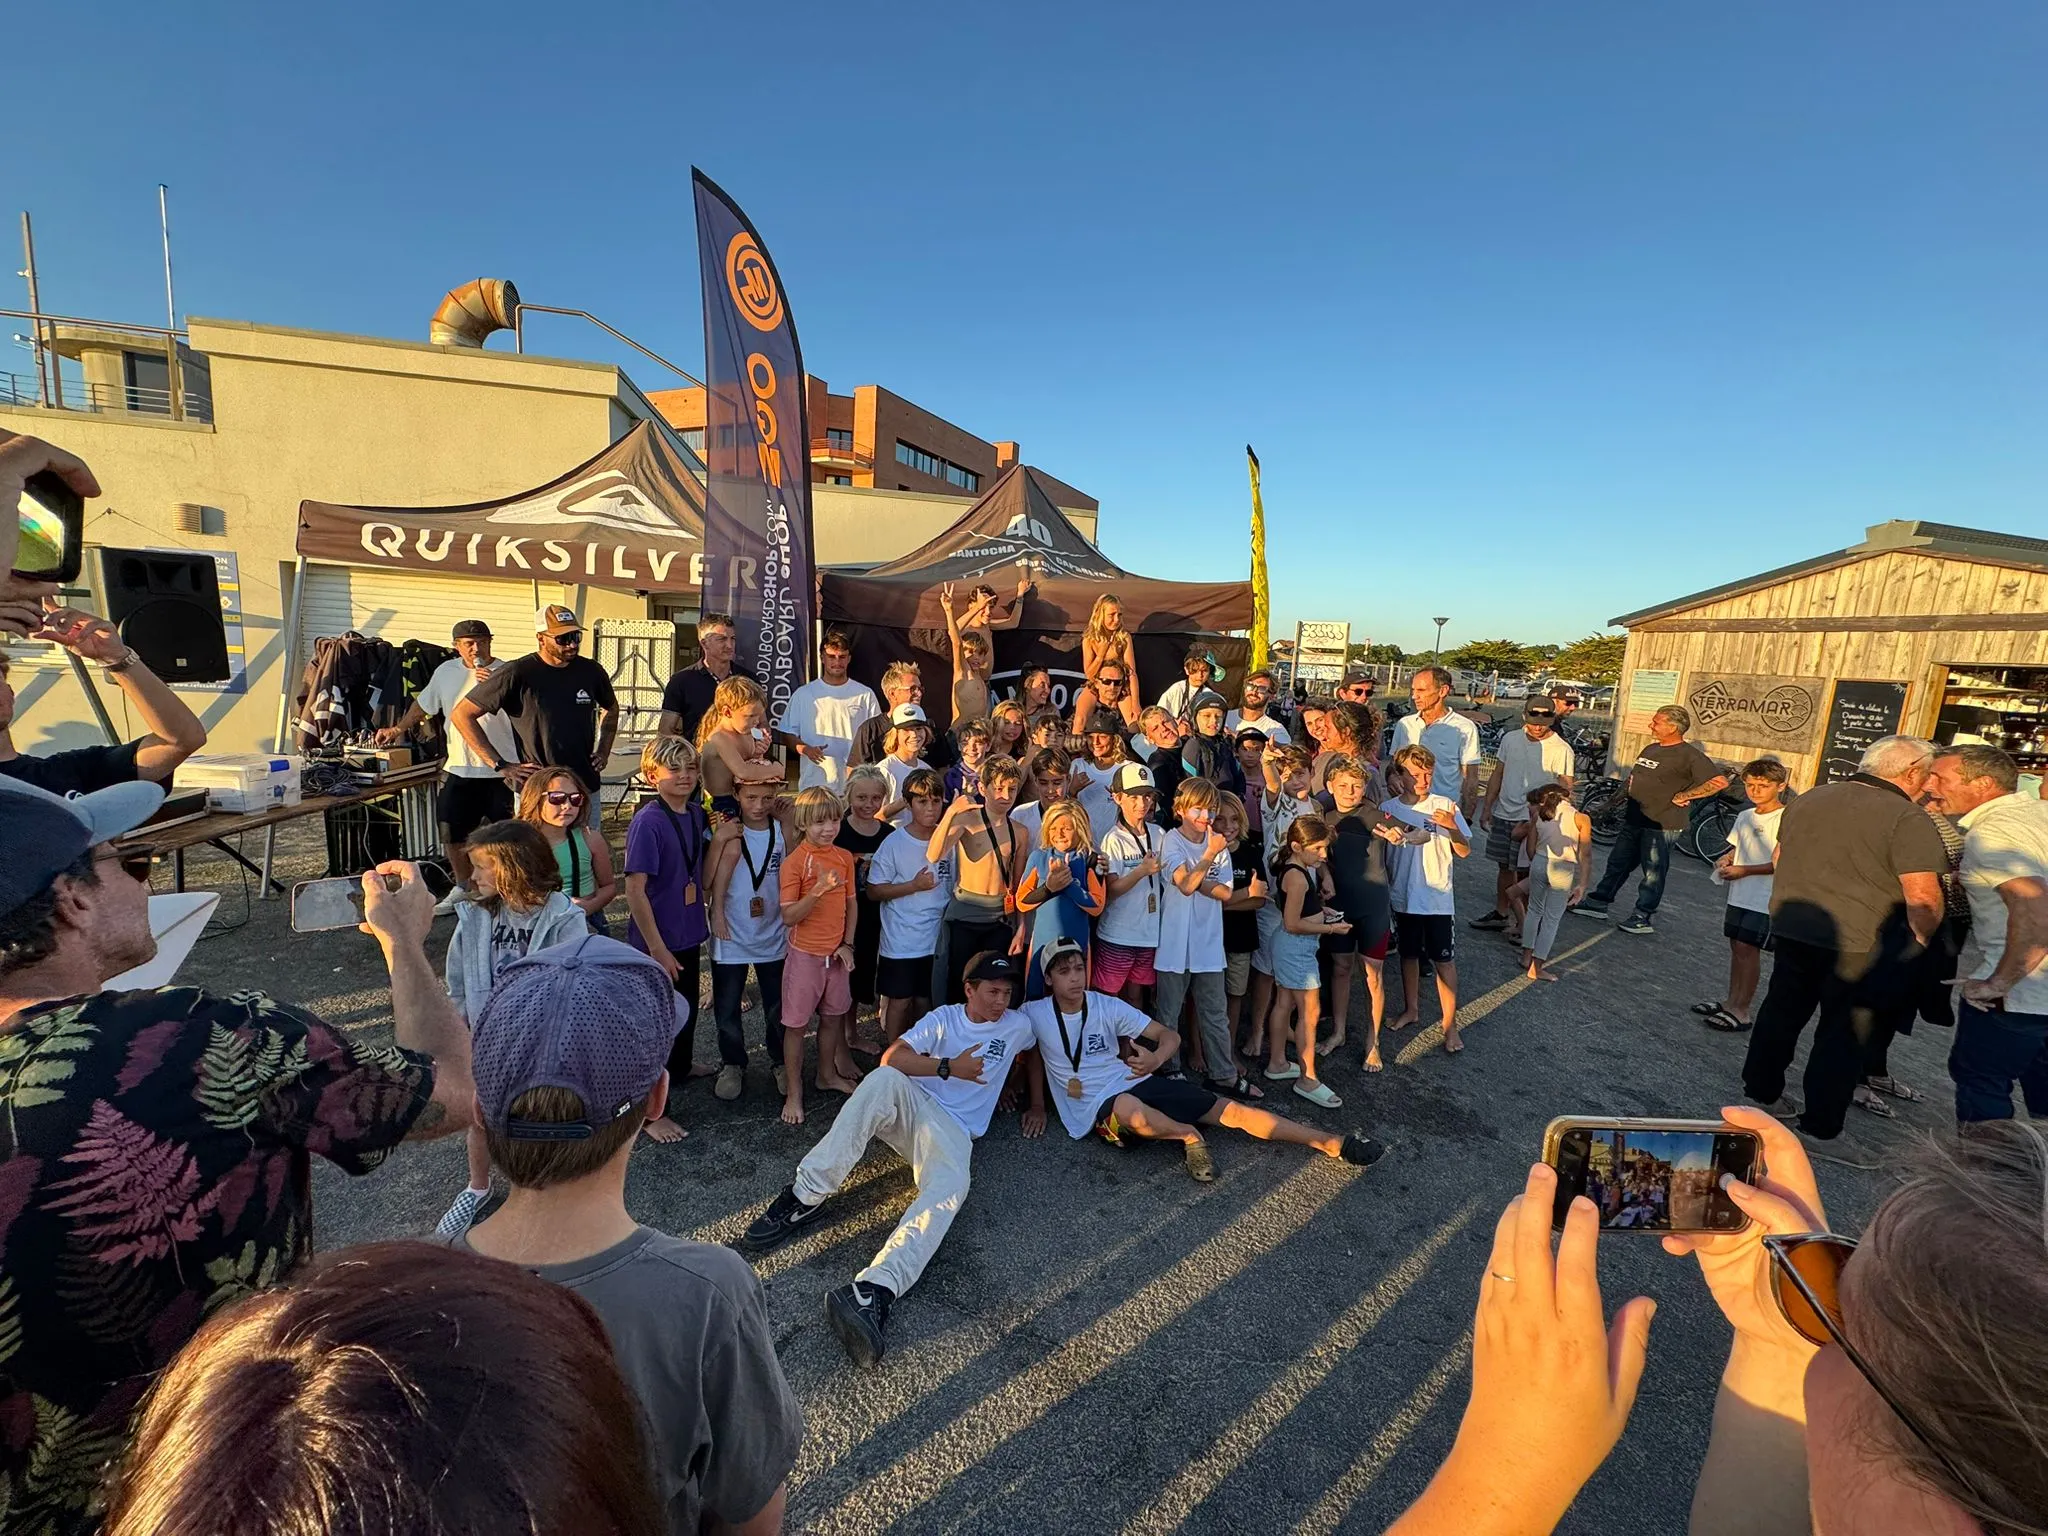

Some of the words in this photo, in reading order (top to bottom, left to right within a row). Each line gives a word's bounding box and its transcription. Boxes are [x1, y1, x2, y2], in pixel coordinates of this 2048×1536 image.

[1005, 514, 1053, 547] 40
[360, 522, 758, 590] QUIKSILVER
[1697, 696, 1791, 715] TERRAMAR
